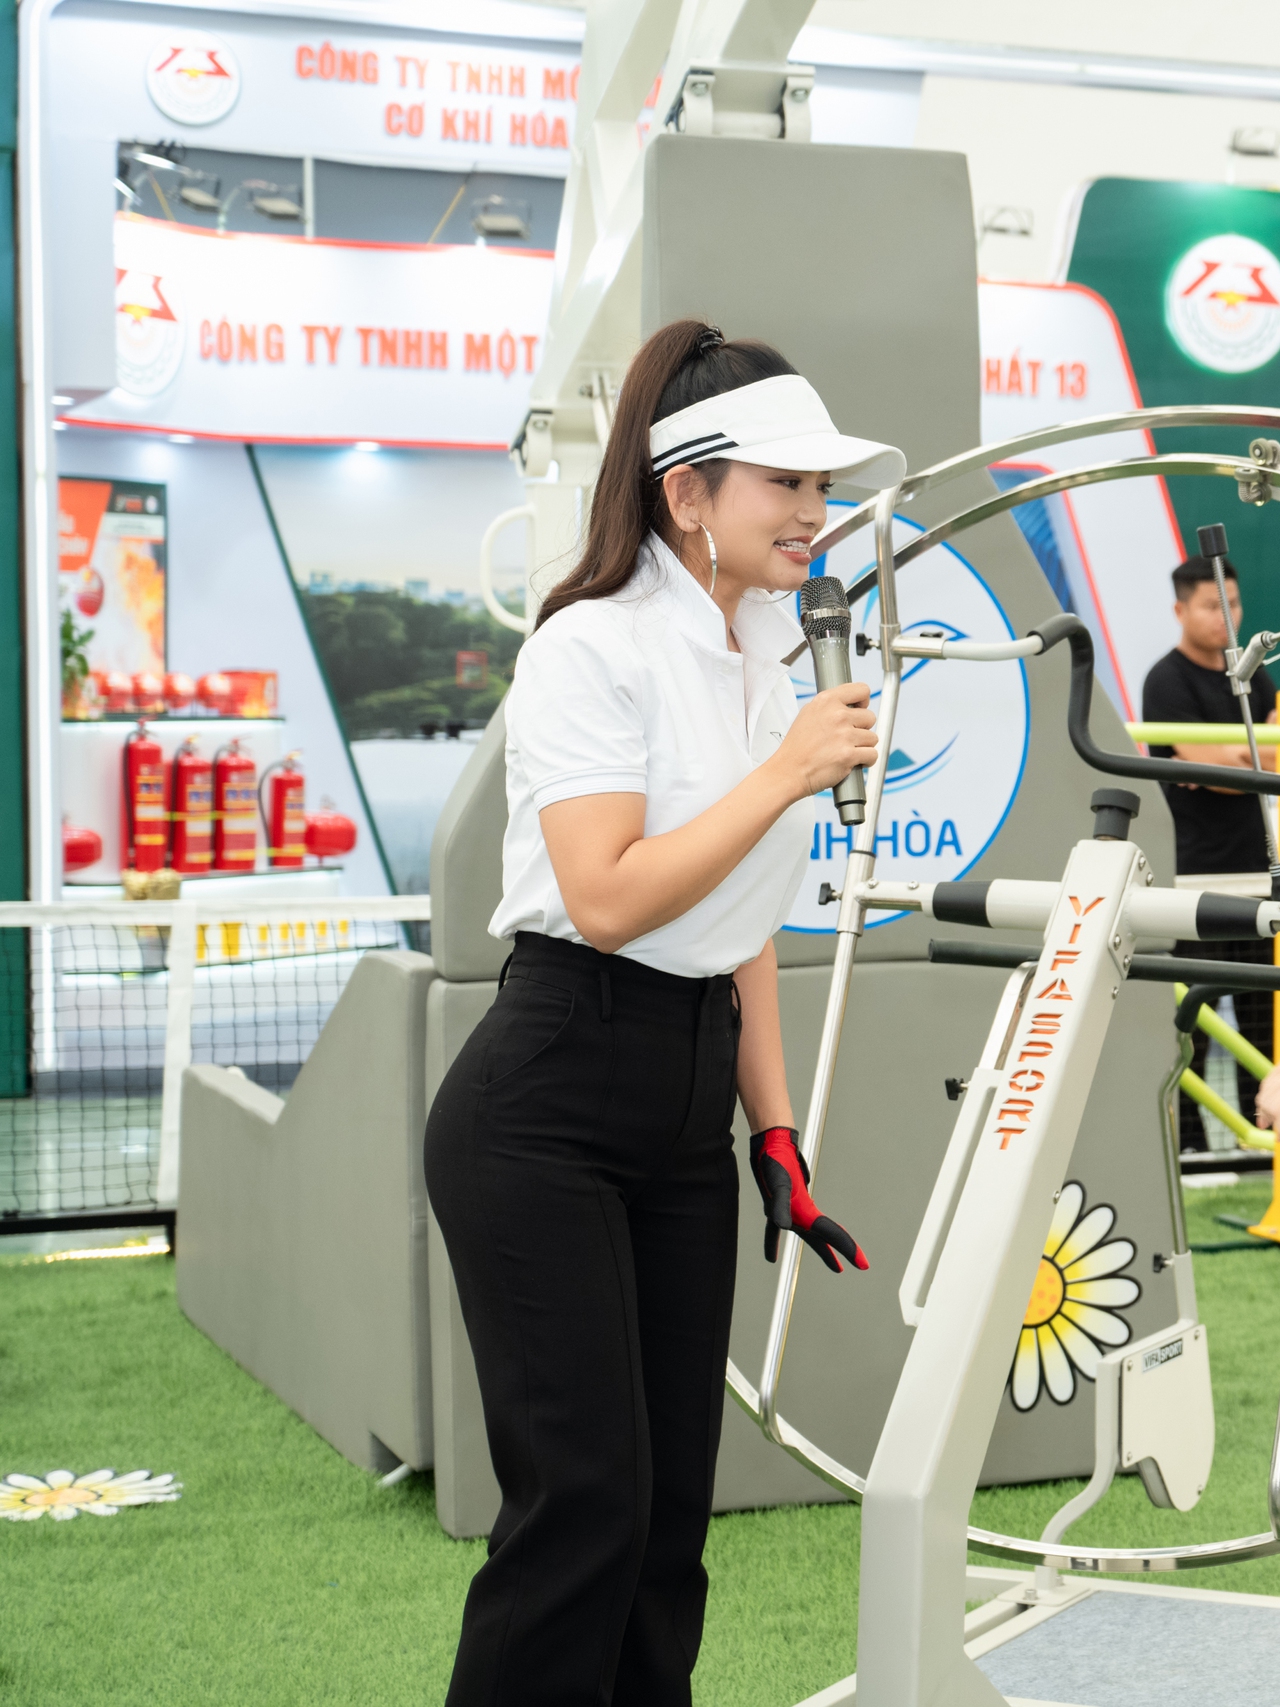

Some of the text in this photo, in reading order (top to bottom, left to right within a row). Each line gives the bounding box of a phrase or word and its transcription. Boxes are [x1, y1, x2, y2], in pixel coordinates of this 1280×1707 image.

[295, 41, 379, 84] CÔNG
[396, 55, 429, 88] TY
[447, 61, 526, 97] TNHH
[441, 105, 493, 143] KHÍ
[510, 110, 569, 149] HÓA
[200, 315, 538, 379] CÔNG TY TNHH MỘT
[1055, 361, 1088, 400] 13
[872, 809, 963, 858] HÒA
